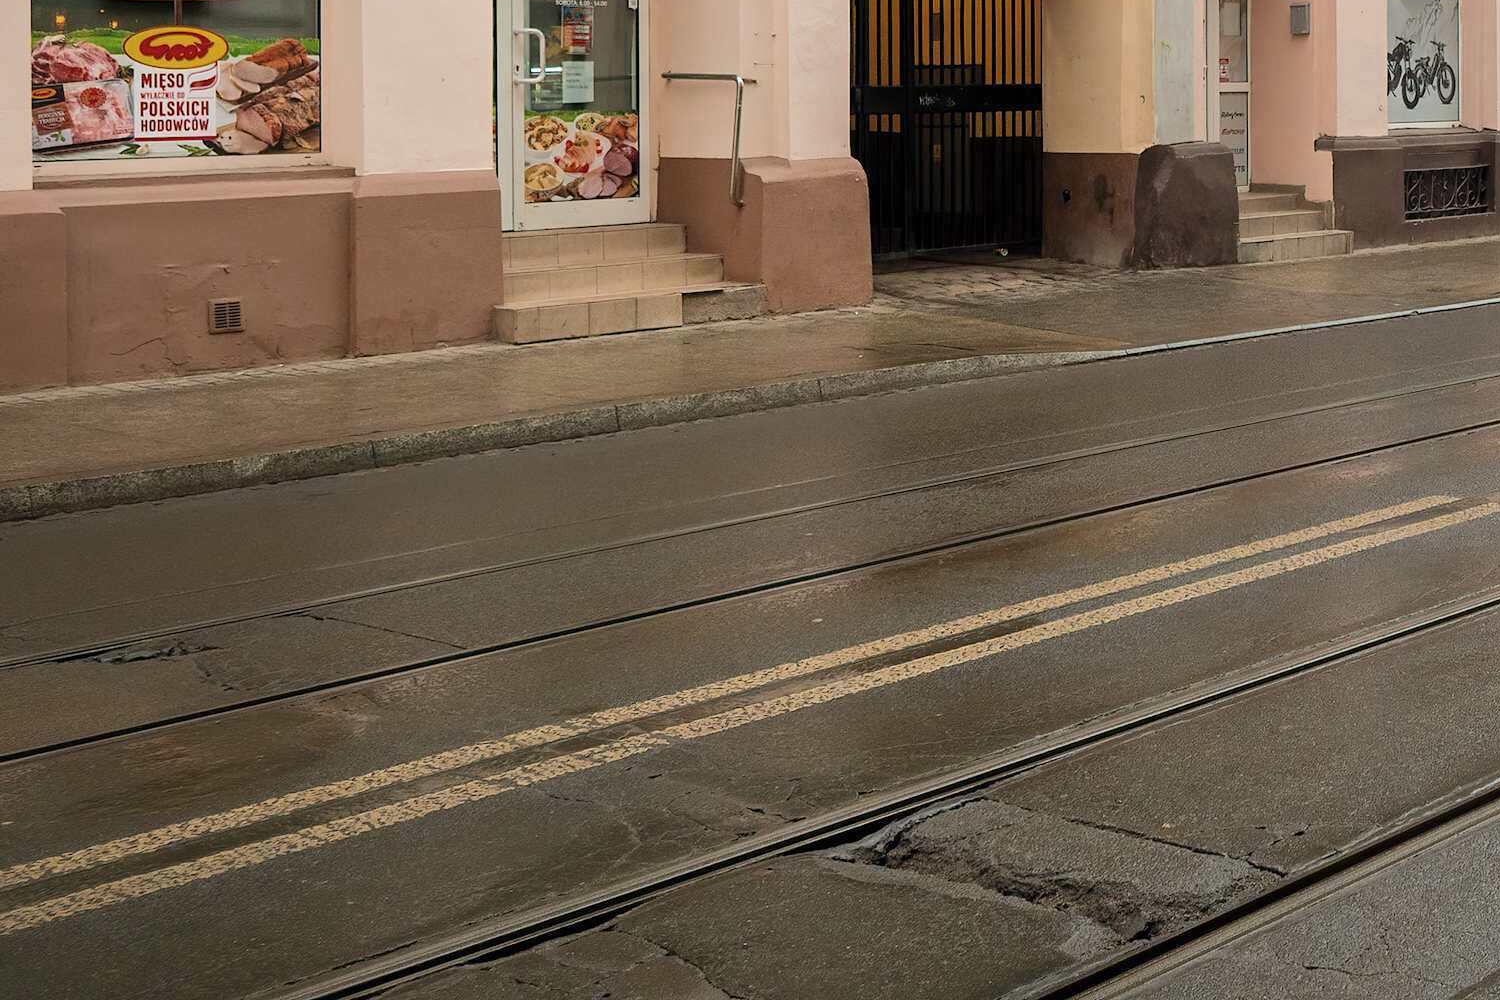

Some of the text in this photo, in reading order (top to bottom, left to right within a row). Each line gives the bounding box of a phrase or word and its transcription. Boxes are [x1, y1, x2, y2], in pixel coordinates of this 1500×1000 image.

[141, 73, 184, 91] MIĘSO
[140, 101, 209, 117] POLSKICH
[141, 118, 209, 133] HODOWCÓW
